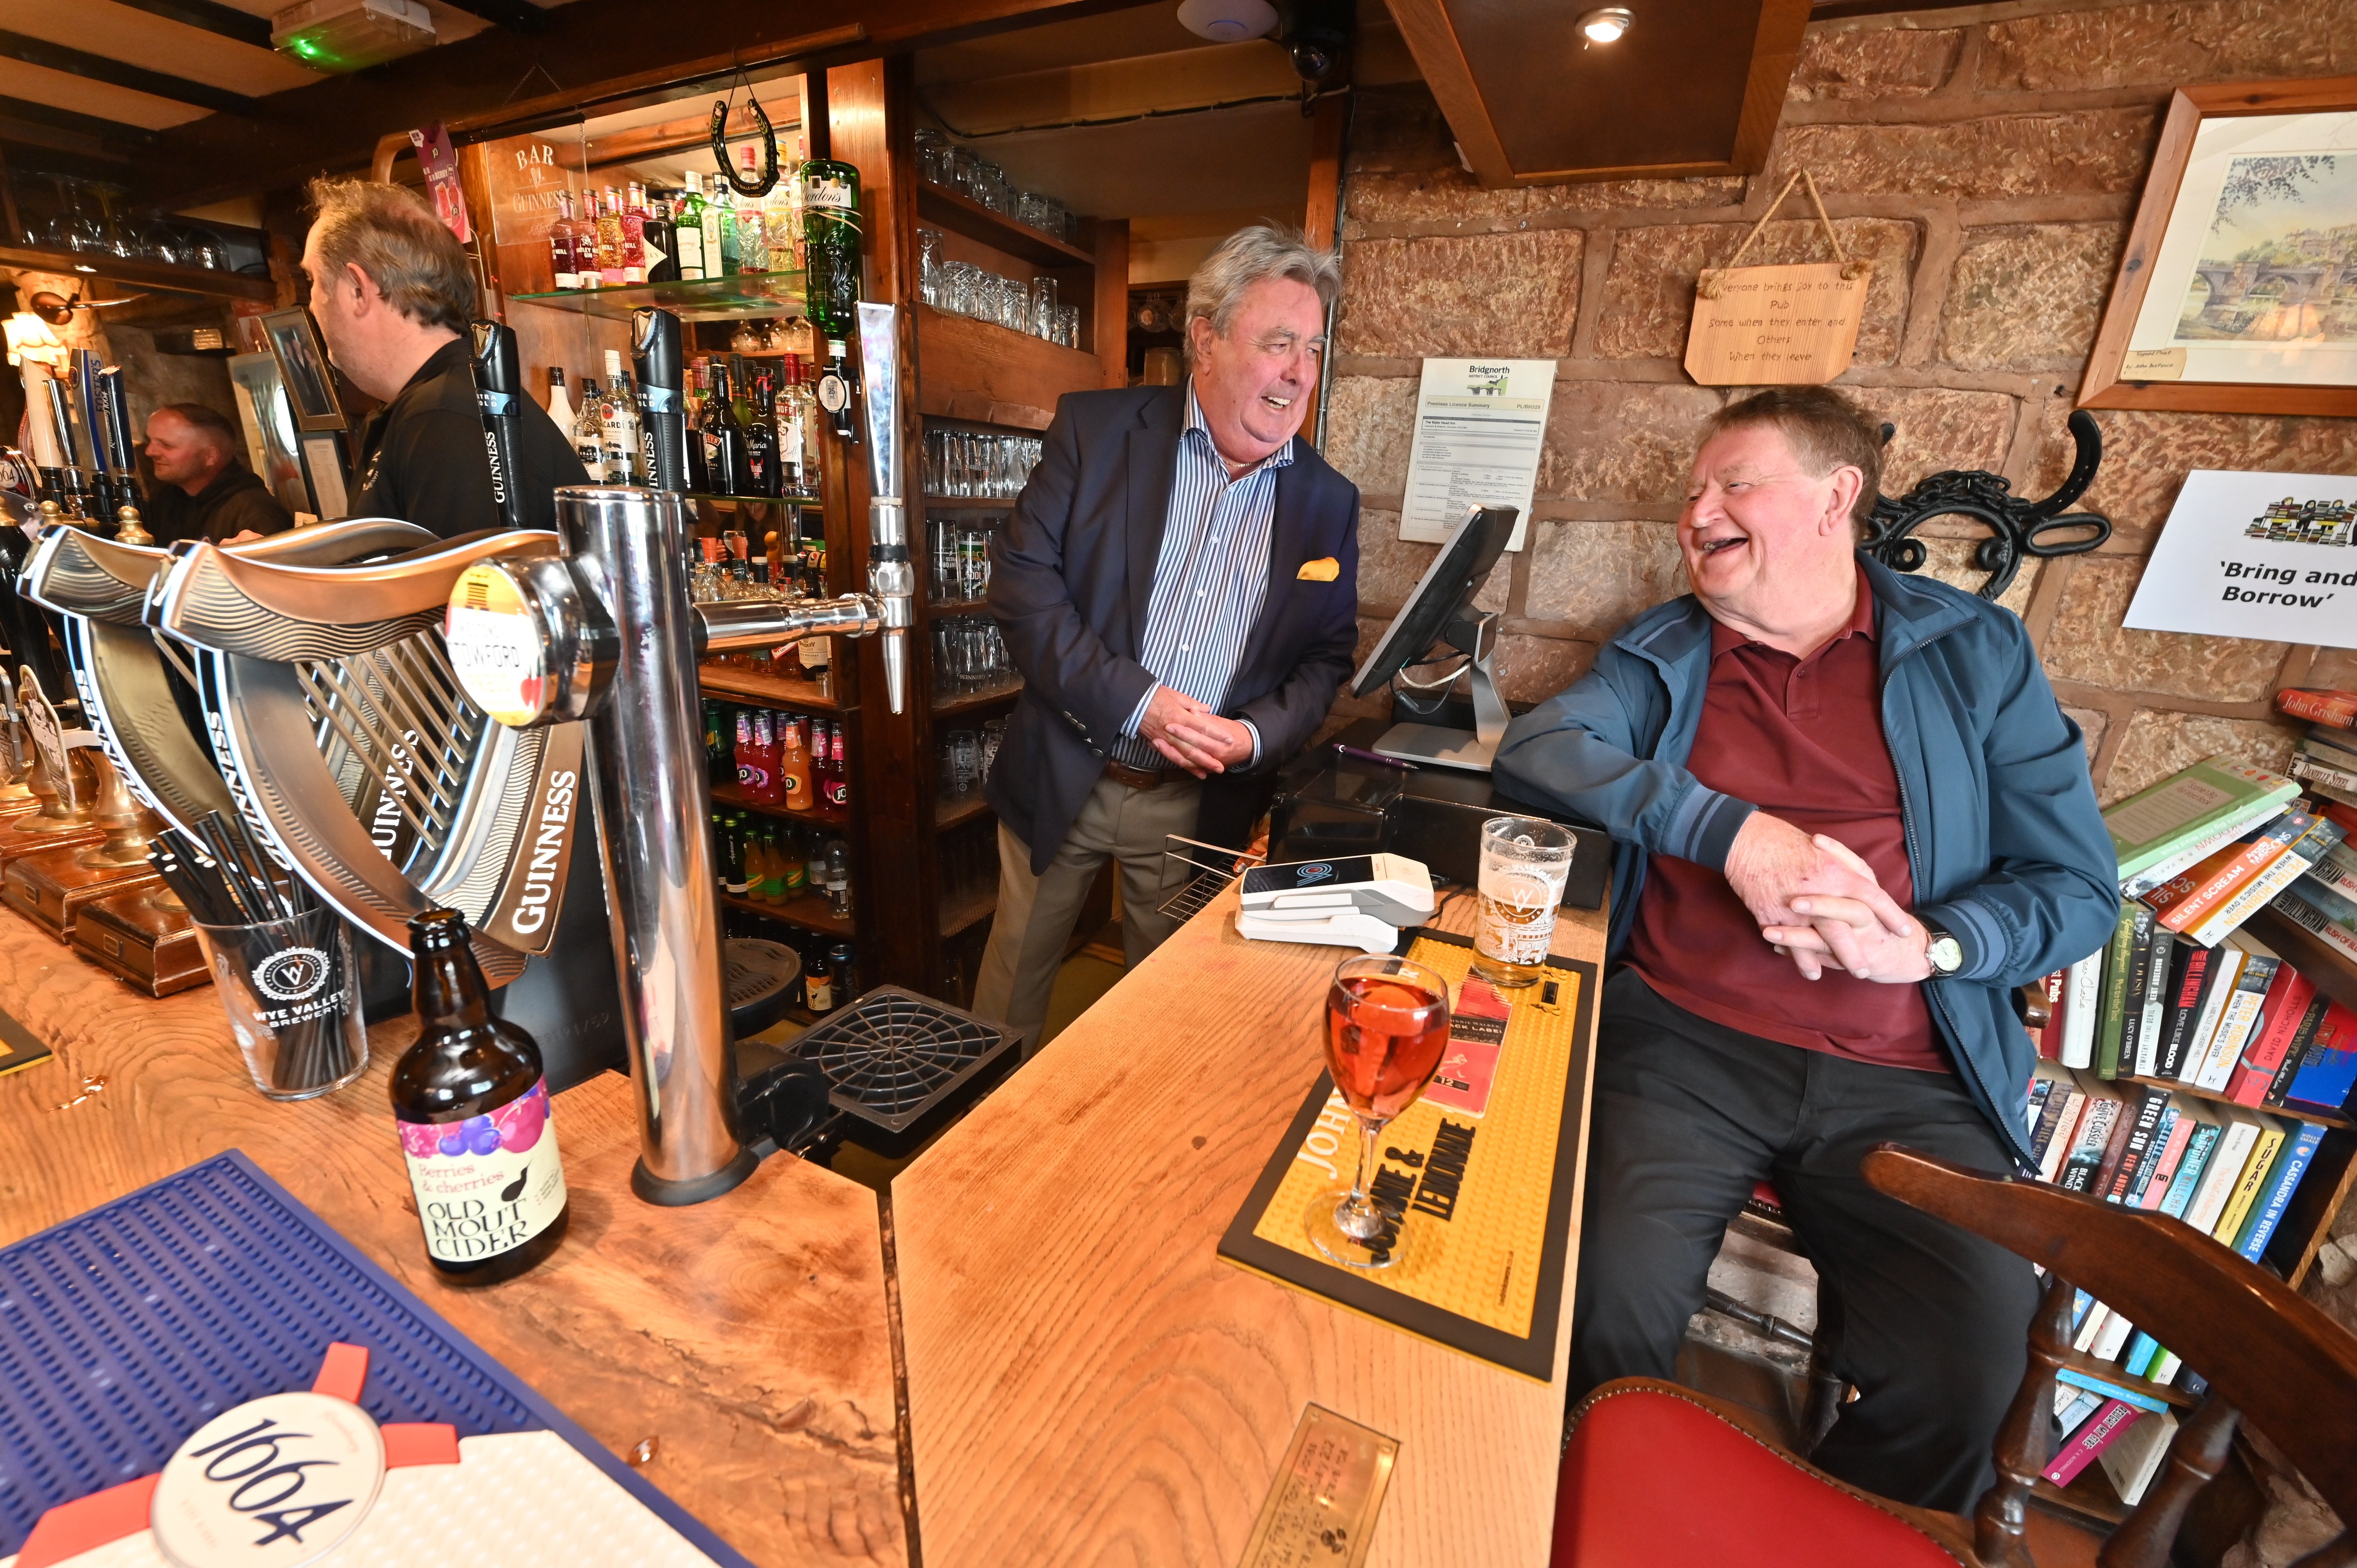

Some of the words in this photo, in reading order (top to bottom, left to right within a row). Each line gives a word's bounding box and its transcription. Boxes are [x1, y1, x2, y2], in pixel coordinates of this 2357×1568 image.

[515, 145, 553, 171] BAR
[513, 189, 566, 213] GUINNESS
[801, 186, 842, 203] Gordon's
[1722, 283, 1758, 292] veryone
[1764, 281, 1793, 293] brings
[1796, 283, 1812, 293] joy
[1818, 282, 1829, 290] to
[1835, 282, 1853, 290] this
[1770, 300, 1790, 309] Pub
[1709, 317, 1733, 328] Some
[1739, 317, 1763, 327] when
[1769, 317, 1790, 328] they
[1796, 318, 1822, 327] enter
[1827, 317, 1845, 326] and
[1757, 335, 1791, 345] Others
[1761, 352, 1781, 362] they
[1786, 352, 1811, 361] leave
[1469, 366, 1510, 374] Bridgnorth
[90, 359, 104, 413] FOSTER'S
[486, 431, 505, 503] GUINNESS
[2220, 560, 2297, 584] ‘Bring
[2305, 570, 2357, 586] and
[2221, 586, 2335, 608] Borrow’
[2283, 694, 2308, 713] John
[2309, 702, 2354, 727] Grisham
[2300, 763, 2330, 783] DANIELLE
[2329, 772, 2350, 789] STEEL
[512, 770, 576, 934] GUINNESS
[2274, 854, 2294, 870] WHEN
[2152, 862, 2176, 878] PARIS
[2263, 869, 2276, 882] THE
[2271, 858, 2306, 886] PETER
[2171, 897, 2205, 925] SILENT
[2202, 865, 2245, 901] SCREAM
[2240, 881, 2265, 902] MUSIC'S
[2276, 894, 2291, 909] MARK
[2223, 884, 2276, 927] ROBINSON
[2224, 901, 2240, 915] OVER
[2283, 898, 2330, 934] BILLINGHAM
[2323, 925, 2340, 940] RUSH
[2339, 935, 2350, 945] OF
[2191, 950, 2209, 961] MARK
[2152, 958, 2163, 986] ANDERSON
[2049, 979, 2062, 1003] Pubs
[2149, 987, 2158, 1001] KENT
[2177, 960, 2207, 1008] BILLINGHAM
[252, 1008, 288, 1021] WYE
[292, 988, 345, 1015] VALLEY
[2231, 994, 2245, 1009] WHEN
[2242, 994, 2260, 1022] PETER
[269, 1003, 339, 1028] BREWERY
[2127, 1018, 2135, 1035] LUCY
[2178, 1009, 2188, 1026] LOVE
[2206, 1007, 2217, 1026] MIRACLE
[2226, 1010, 2237, 1022] THE
[2298, 1010, 2316, 1036] PARIS
[2139, 1044, 2149, 1070] SYMPATHY
[2146, 1009, 2155, 1023] DEVIL
[2172, 1026, 2184, 1044] LIKE
[2217, 1021, 2232, 1045] MUSIC'S
[2263, 1036, 2281, 1062] DAVID
[2279, 995, 2302, 1034] NICHOLLS
[2124, 1035, 2134, 1059] O'BRIEN
[2197, 1032, 2208, 1048] CHERRY
[2286, 1033, 2305, 1058] WIFE
[2164, 1043, 2179, 1069] BLOOD
[2193, 1047, 2201, 1058] HILL
[2210, 1044, 2223, 1059] OVER
[1440, 1076, 1454, 1086] 12
[2096, 1102, 2115, 1120] CLIVE
[2138, 1097, 2163, 1129] GREEN
[2085, 1121, 2107, 1147] CUSSLER
[2129, 1131, 2149, 1151] SUN
[2302, 1133, 2321, 1141] HOLLY
[1383, 1145, 1426, 1169] &
[2122, 1153, 2138, 1172] KENT
[2243, 1138, 2277, 1192] SUGAR
[418, 1162, 475, 1177] Berries
[1412, 1117, 1476, 1222] LEMONADE
[2064, 1167, 2079, 1189] WIND
[2073, 1167, 2088, 1192] BLACK
[422, 1180, 433, 1192] &
[436, 1171, 505, 1195] cherries
[2270, 1160, 2302, 1208] CASSANDRA
[427, 1199, 485, 1220] OLD
[433, 1198, 527, 1238] MOUT
[2265, 1209, 2278, 1220] IN
[436, 1221, 532, 1257] CIDER
[2248, 1219, 2273, 1253] REVERSE
[2098, 1384, 2124, 1397] Carmen
[2126, 1393, 2141, 1402] Reid
[2067, 1403, 2088, 1426] Danielle
[2082, 1433, 2101, 1450] FIRE
[2094, 1424, 2109, 1439] MY
[188, 1417, 354, 1546] 1664
